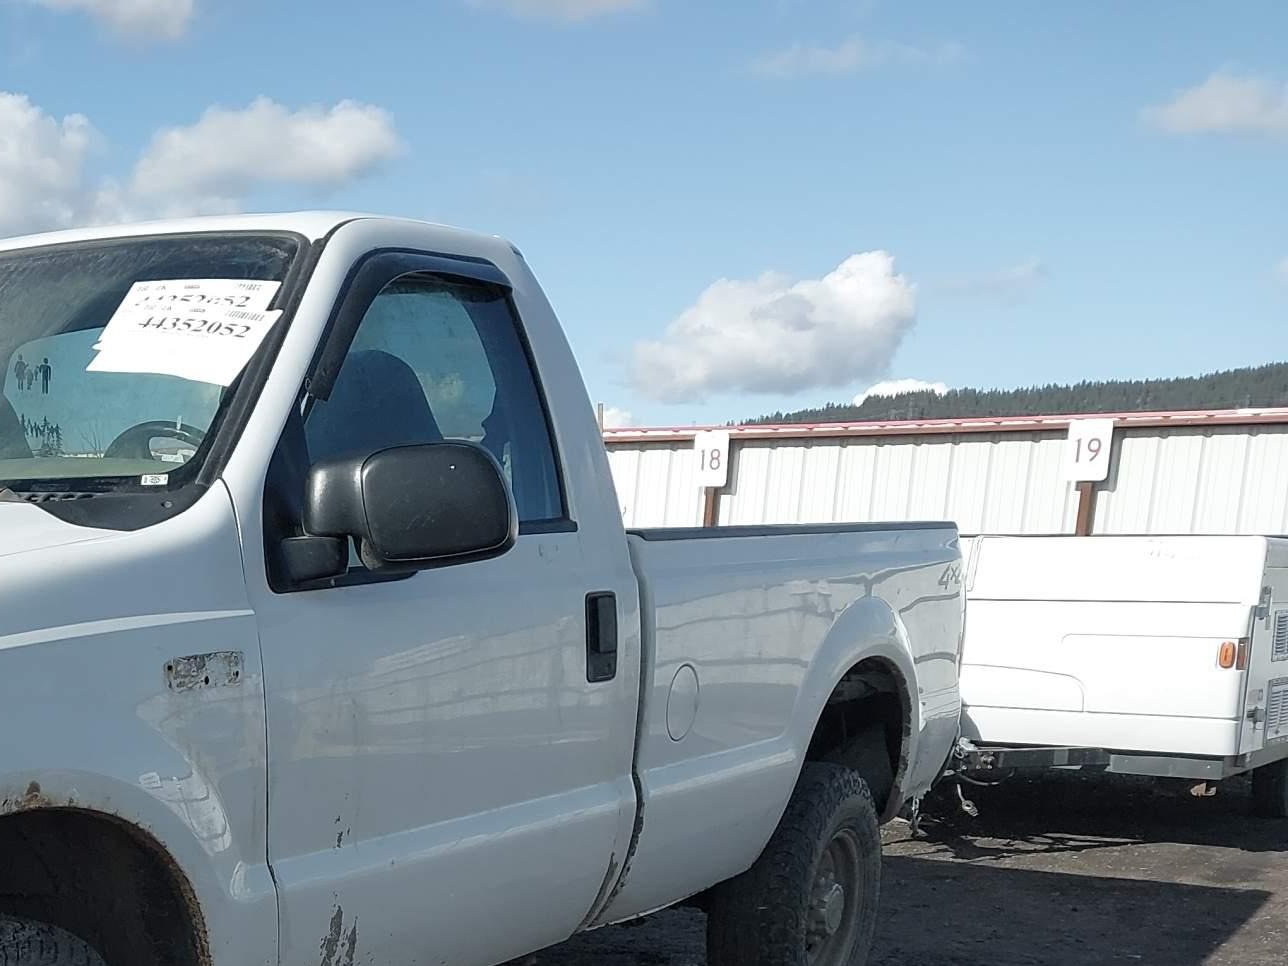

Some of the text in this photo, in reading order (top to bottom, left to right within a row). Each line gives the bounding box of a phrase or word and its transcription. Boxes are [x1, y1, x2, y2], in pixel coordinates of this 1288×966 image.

[138, 316, 252, 339] 44352052
[700, 448, 721, 471] 18
[1075, 437, 1102, 463] 19
